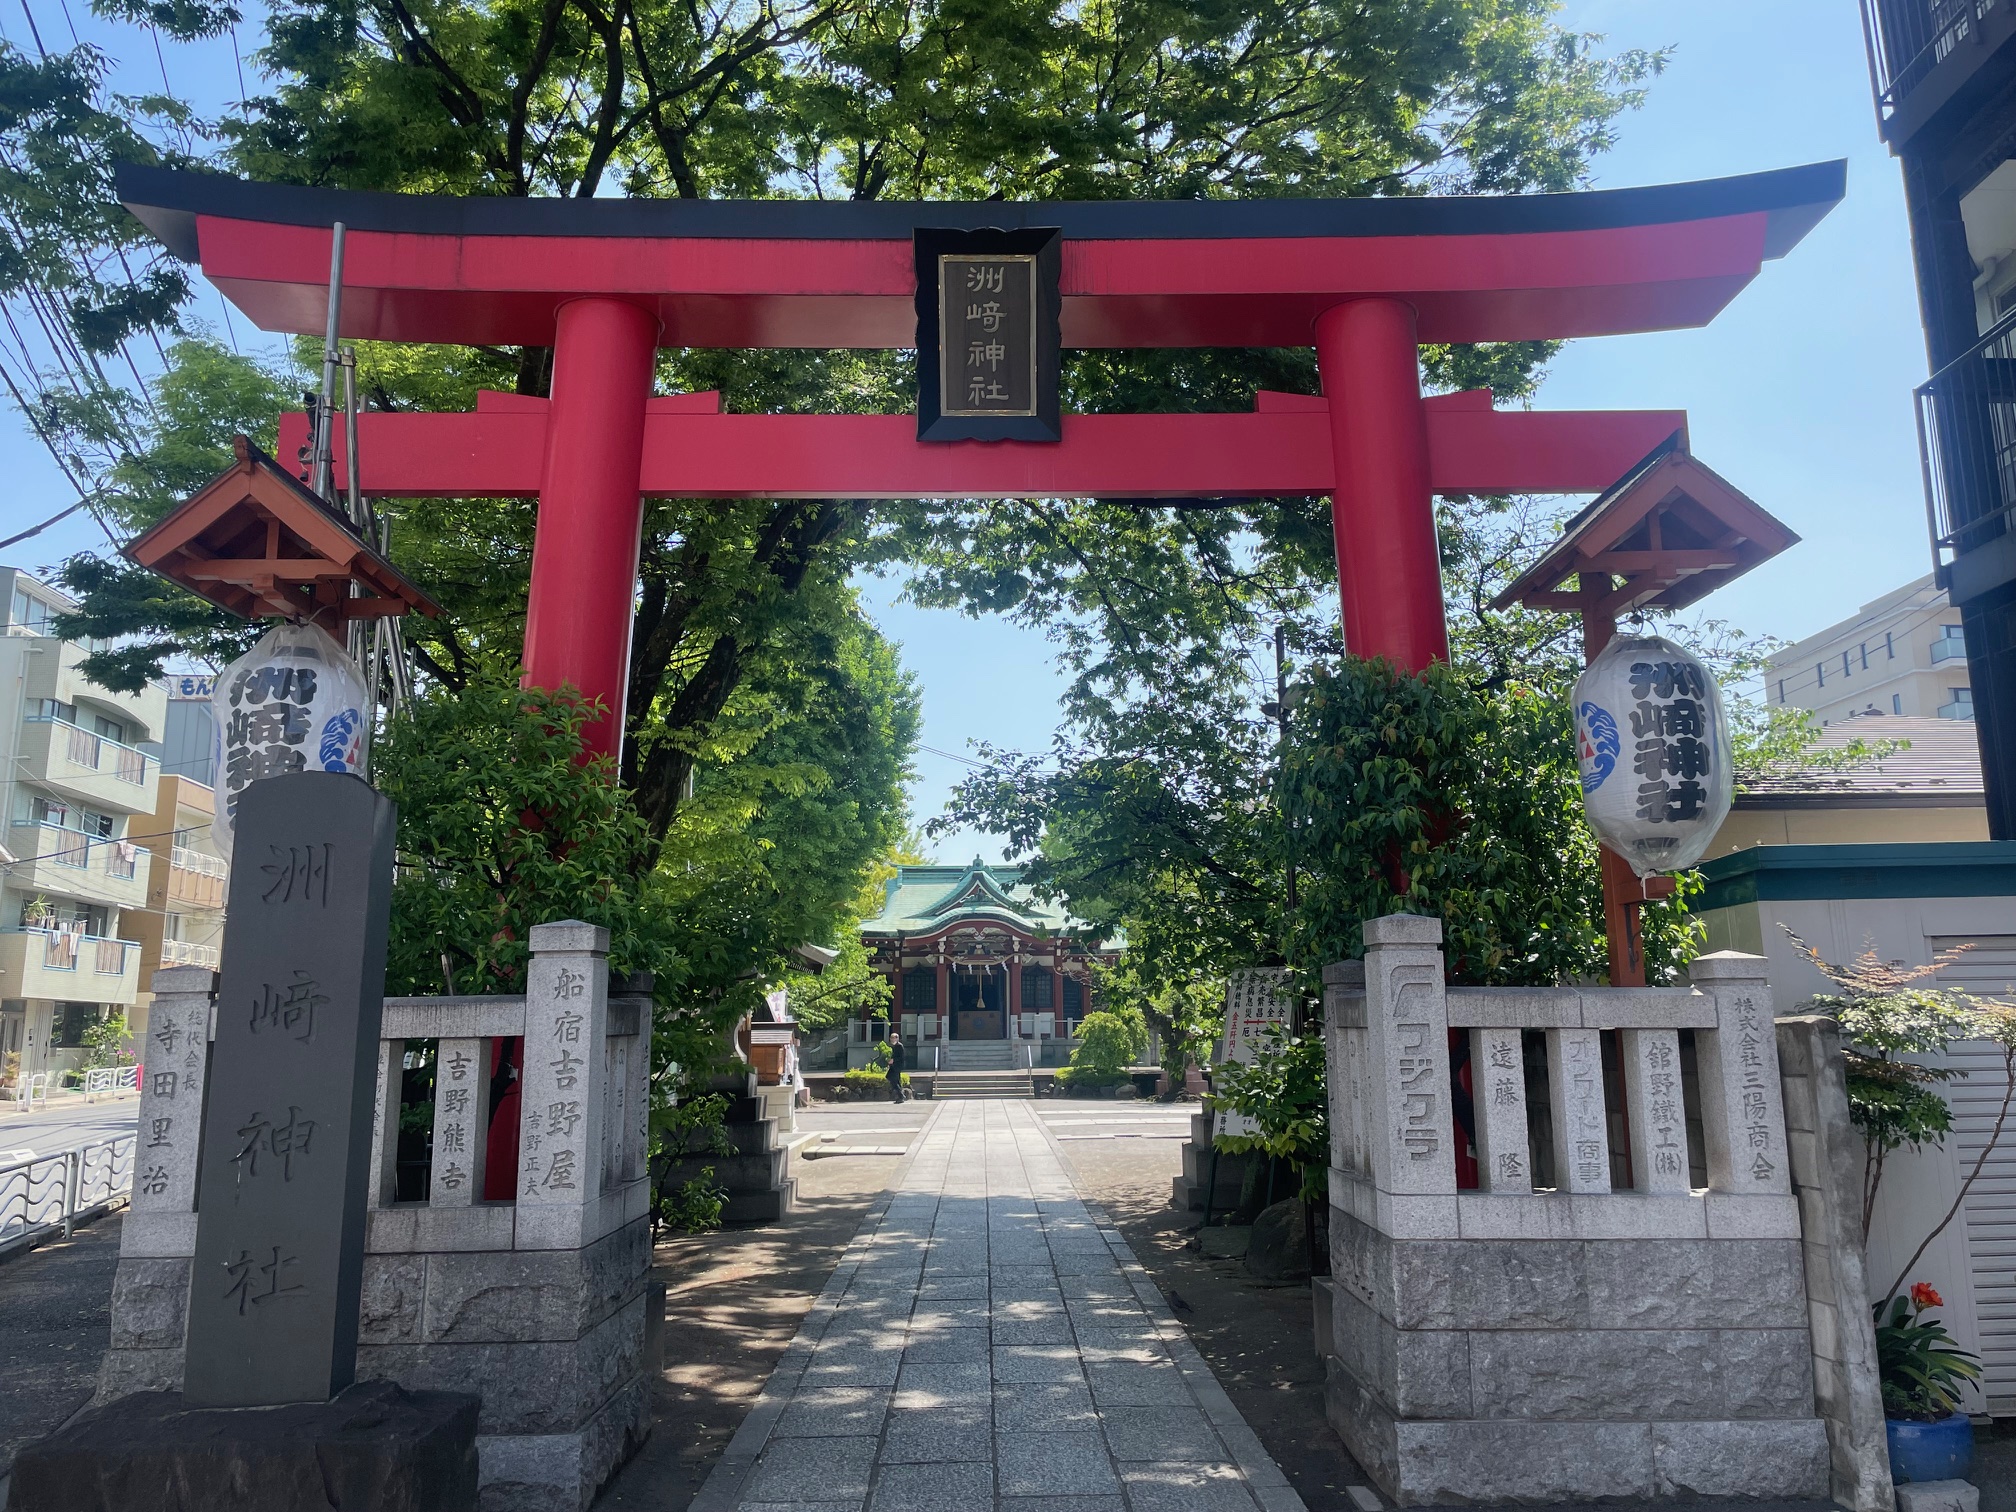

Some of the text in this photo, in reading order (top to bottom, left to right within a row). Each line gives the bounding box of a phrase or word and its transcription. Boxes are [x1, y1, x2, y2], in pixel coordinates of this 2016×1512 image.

[181, 677, 217, 696] もん
[143, 1018, 182, 1195] 寺田里治
[524, 1110, 544, 1196] 吉野正夫
[541, 967, 585, 1191] 船宿吉野屋
[1397, 1023, 1438, 1161] フジクラ
[1570, 1036, 1601, 1184] オンワード商事
[1734, 997, 1776, 1182] 株式会社三陽商会
